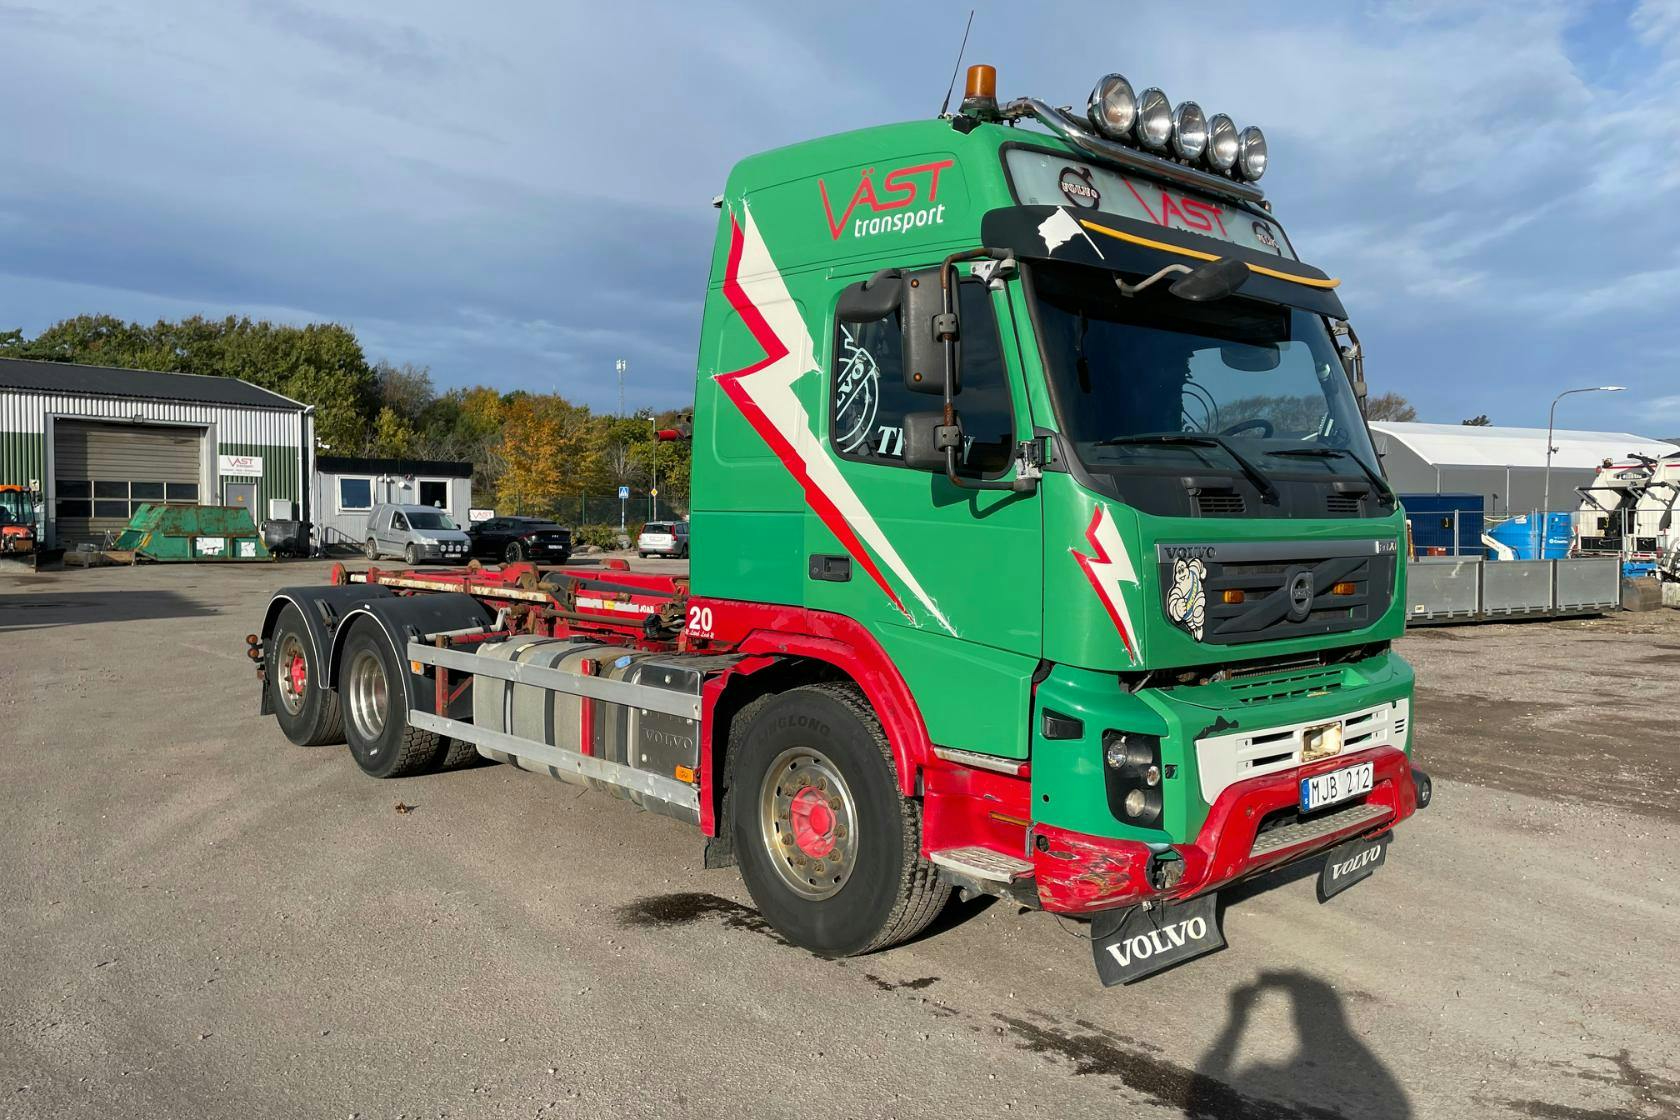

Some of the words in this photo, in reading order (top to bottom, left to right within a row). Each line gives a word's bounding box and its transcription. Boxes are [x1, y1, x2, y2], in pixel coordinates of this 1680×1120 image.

[818, 160, 954, 240] VÄST
[854, 203, 945, 238] transport
[1164, 545, 1217, 559] VOLVO
[689, 606, 713, 631] 20
[643, 727, 693, 750] VOLVO
[1311, 776, 1338, 804] MJB
[1346, 767, 1370, 793] 212
[1332, 845, 1381, 880] VOLVO
[1106, 916, 1207, 967] VOLVO
